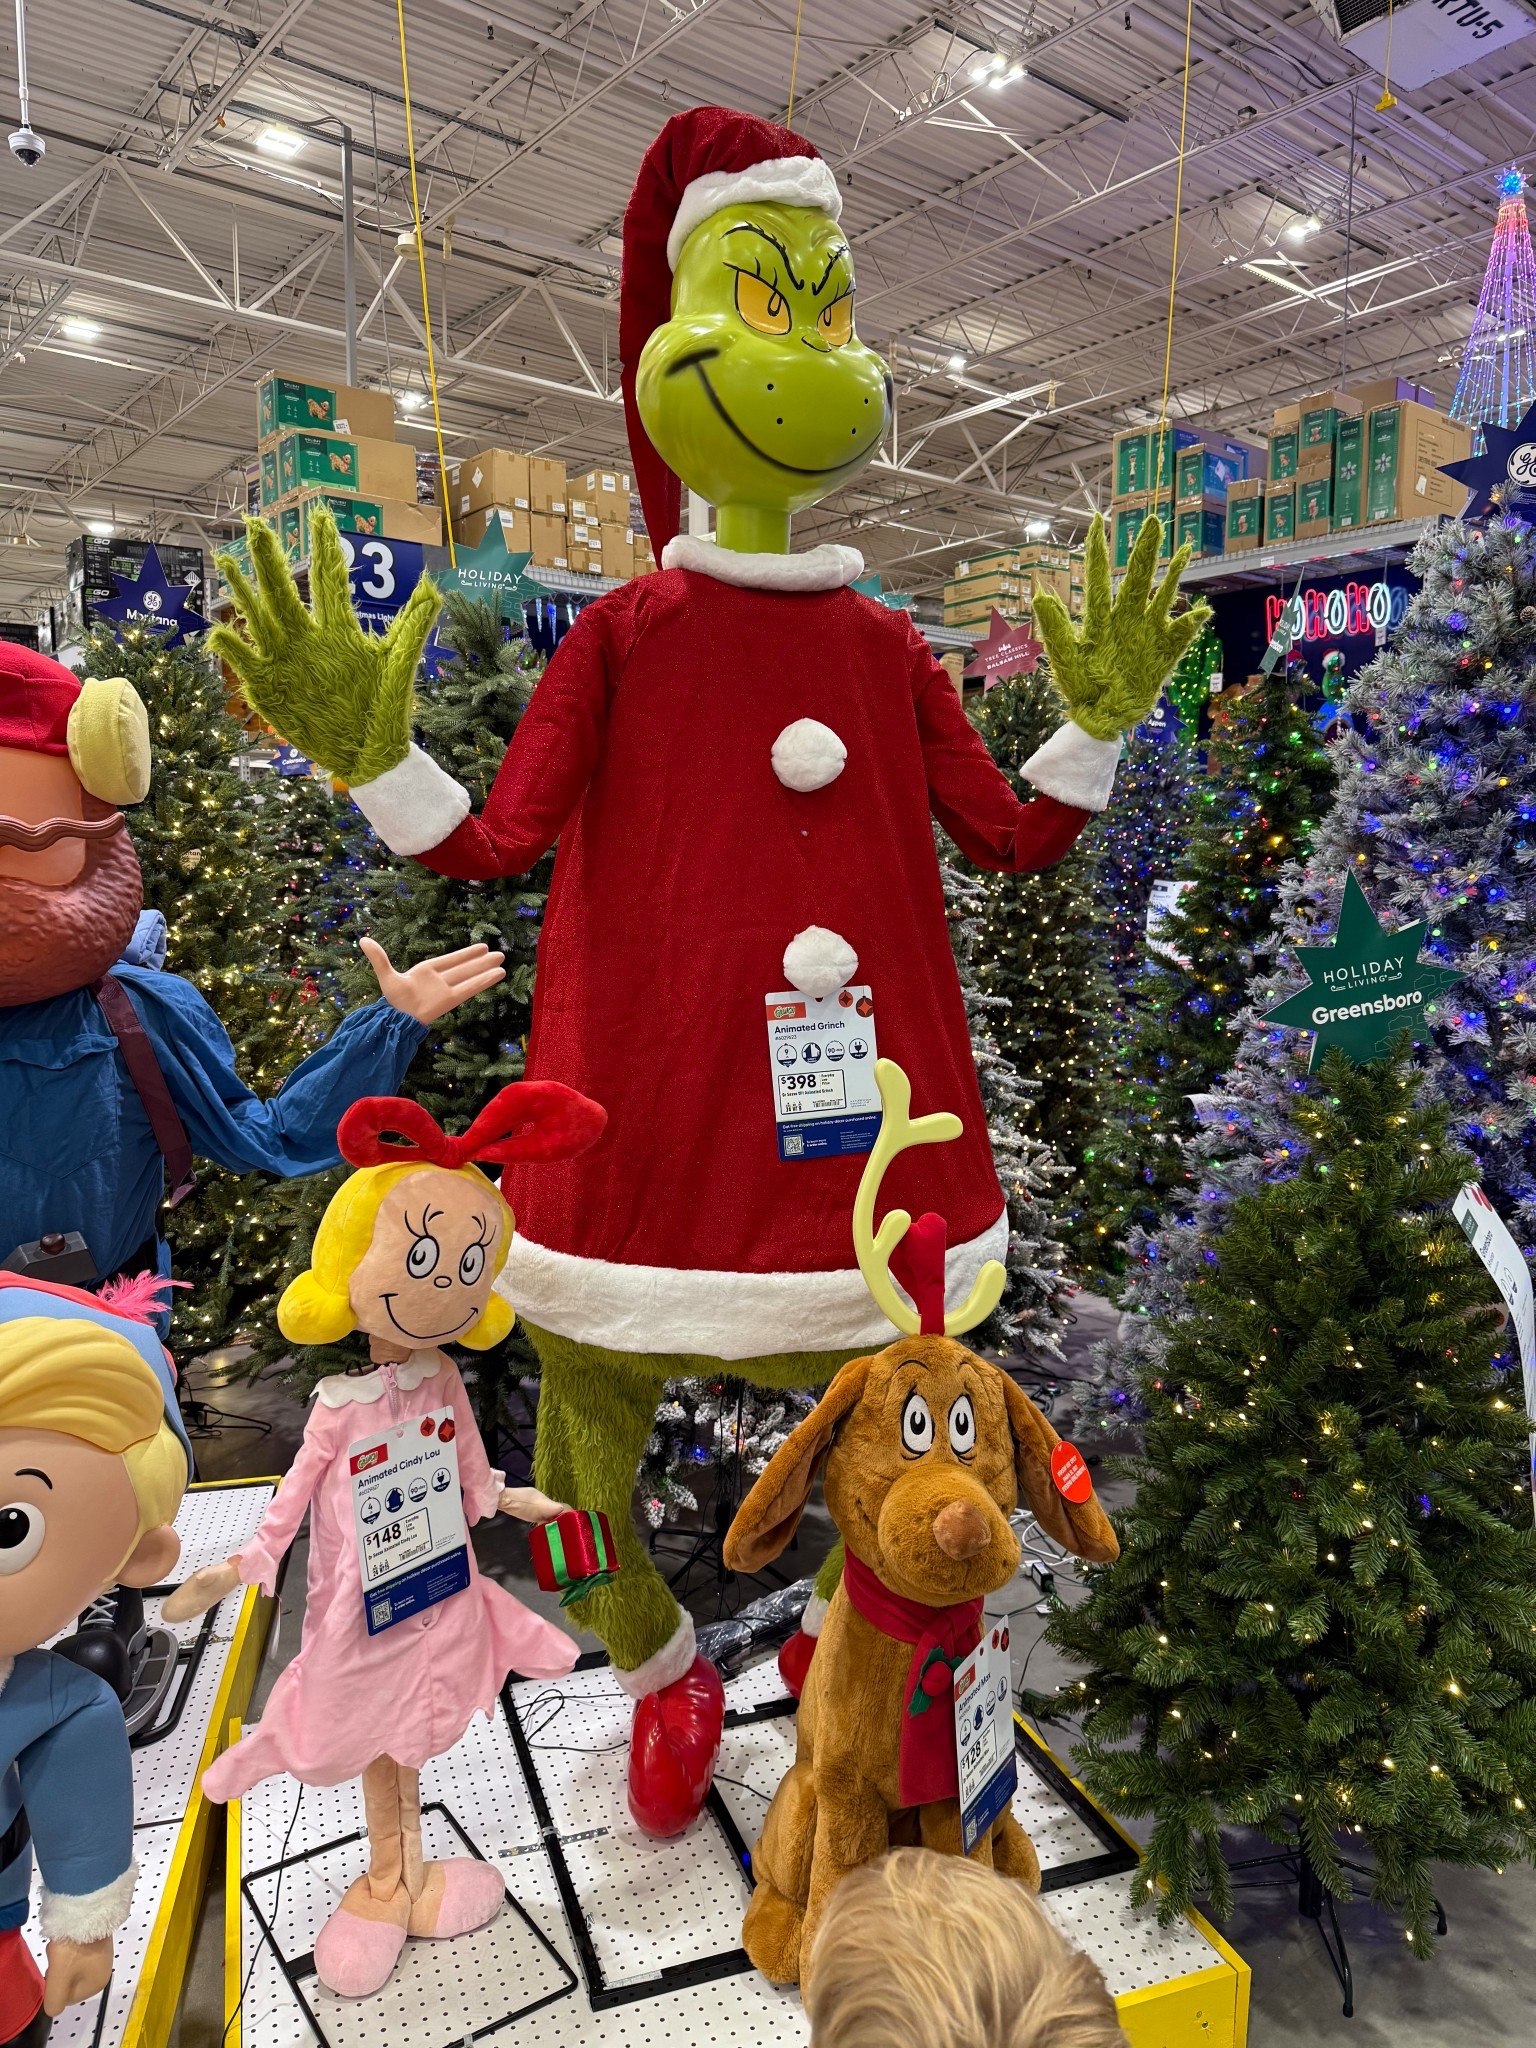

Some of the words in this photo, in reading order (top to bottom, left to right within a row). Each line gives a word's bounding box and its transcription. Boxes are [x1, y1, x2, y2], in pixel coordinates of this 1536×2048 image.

[85, 537, 110, 545] EGO
[458, 568, 523, 584] HOLIDAY
[85, 588, 110, 596] EGO
[474, 581, 503, 590] LIVING
[377, 613, 396, 622] Light
[985, 654, 999, 662] TREE
[1000, 643, 1028, 657] CLASSICS
[986, 657, 1013, 670] BALSAM
[1014, 651, 1030, 660] HILL
[1323, 956, 1404, 984] HOLIDAY
[1348, 974, 1386, 989] LIVING
[1312, 990, 1423, 1025] Greensboro
[774, 1023, 816, 1034] Animated
[817, 1021, 845, 1030] Grinch
[781, 1074, 817, 1090] $398
[357, 1463, 398, 1489] Animated
[399, 1455, 424, 1470] Cindy
[424, 1449, 441, 1460] Lou
[366, 1523, 401, 1549] $148
[958, 1681, 981, 1714] Animated
[980, 1672, 991, 1686] Max
[962, 1741, 982, 1769] $128
